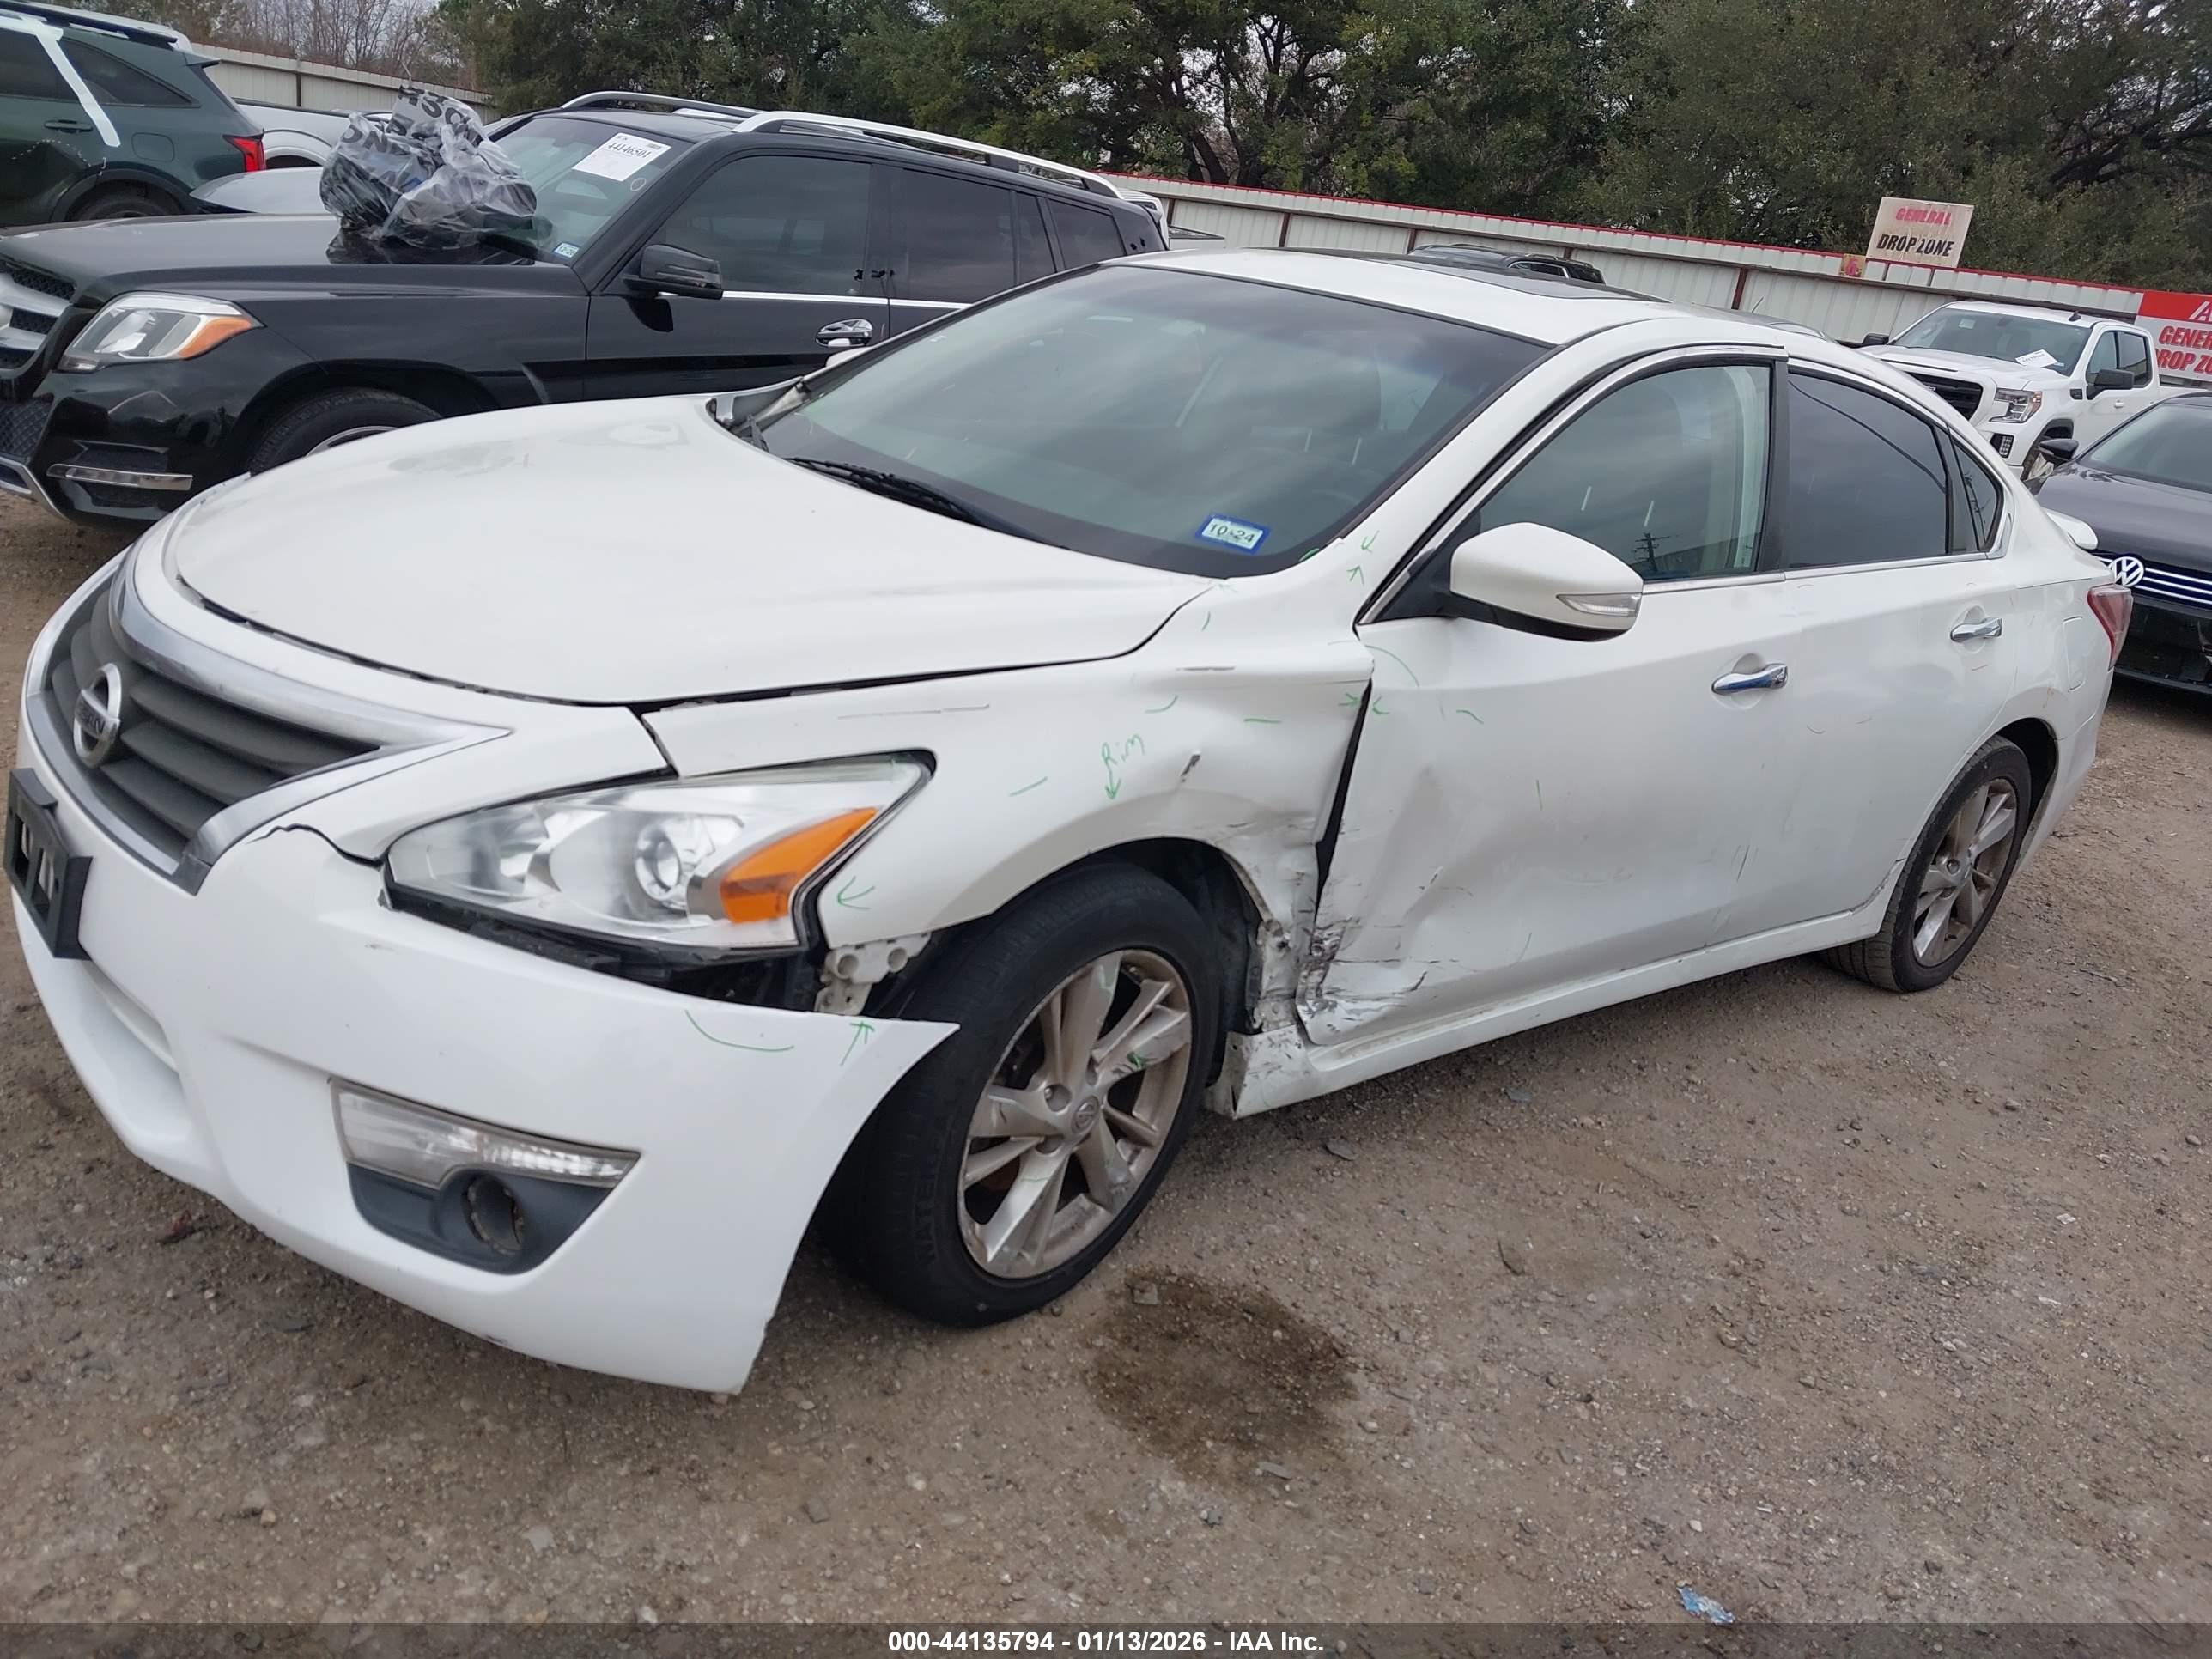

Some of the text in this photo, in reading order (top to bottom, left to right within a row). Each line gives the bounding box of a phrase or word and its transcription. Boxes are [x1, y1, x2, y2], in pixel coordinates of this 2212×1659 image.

[1895, 207, 1952, 225] GENERAL
[1876, 234, 1954, 257] DROP ZONE
